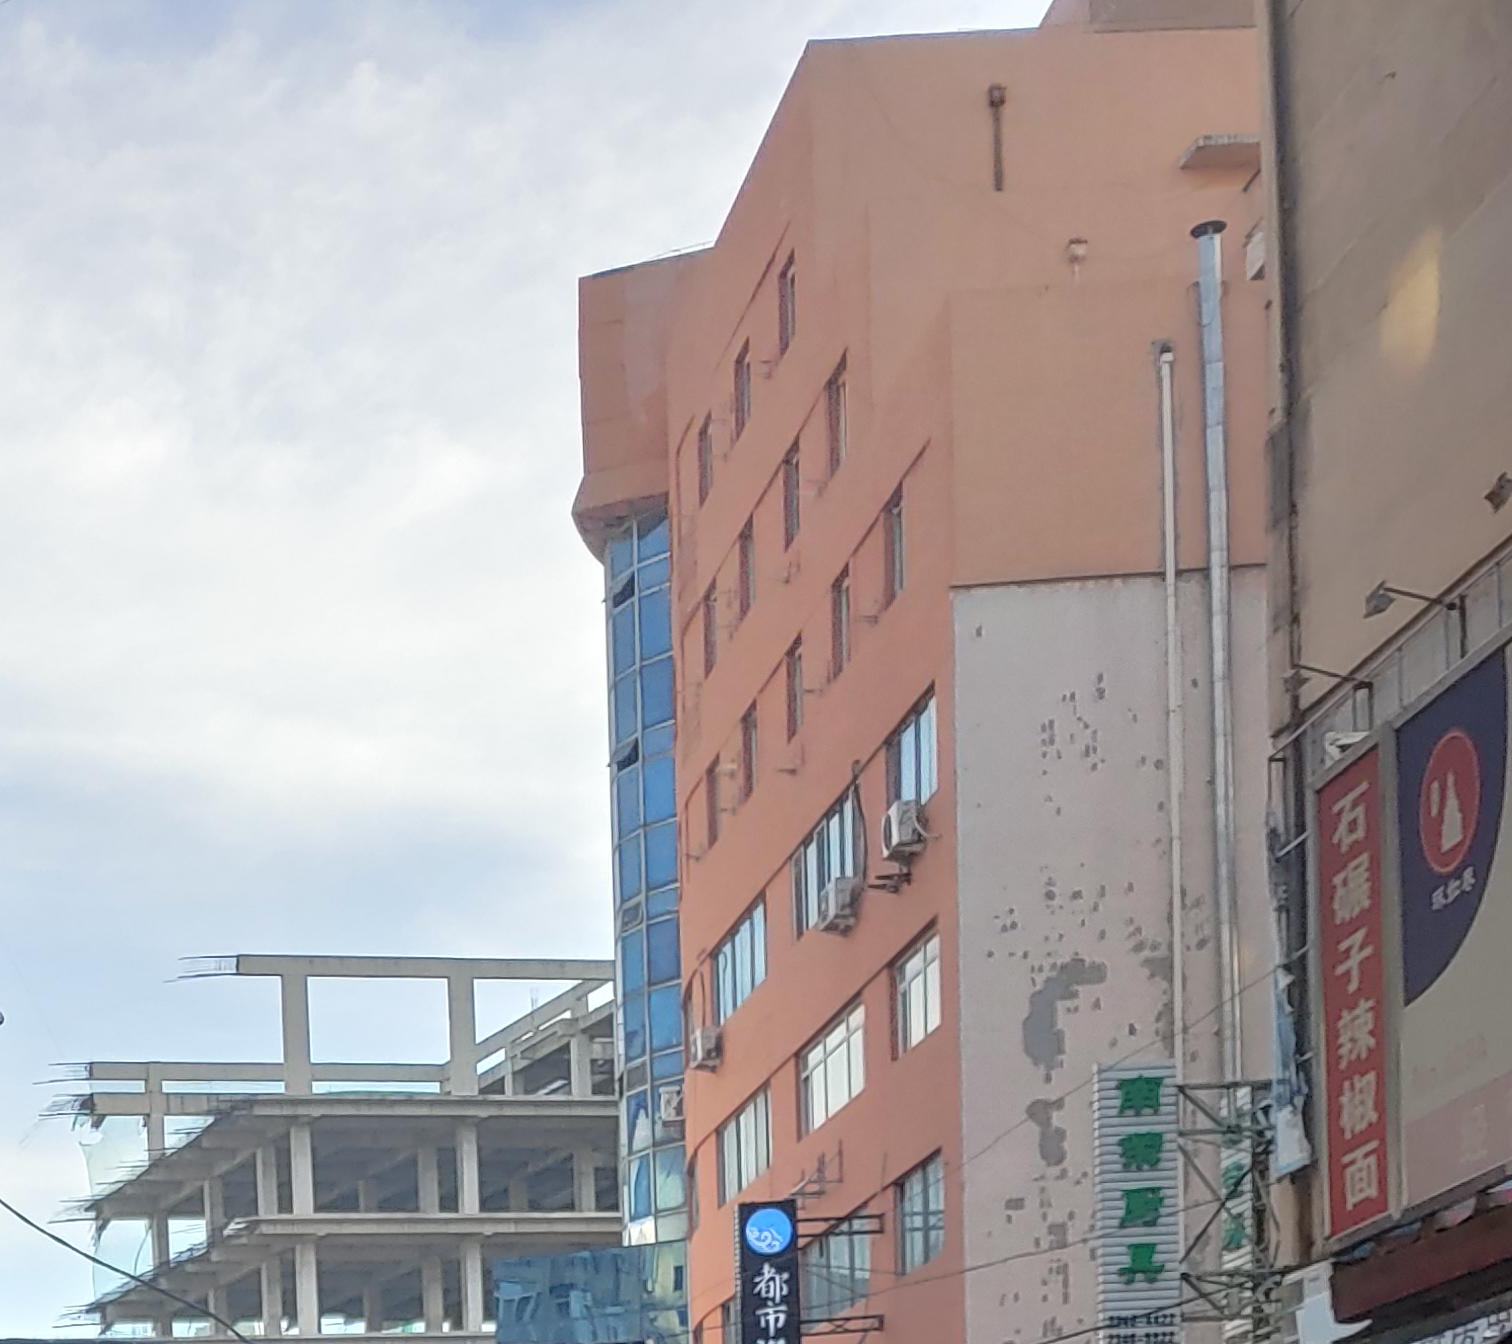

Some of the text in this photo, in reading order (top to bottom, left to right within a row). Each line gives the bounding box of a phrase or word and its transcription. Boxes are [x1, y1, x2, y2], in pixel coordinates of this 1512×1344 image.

[1330, 780, 1380, 1213] 石碾子辣椒面
